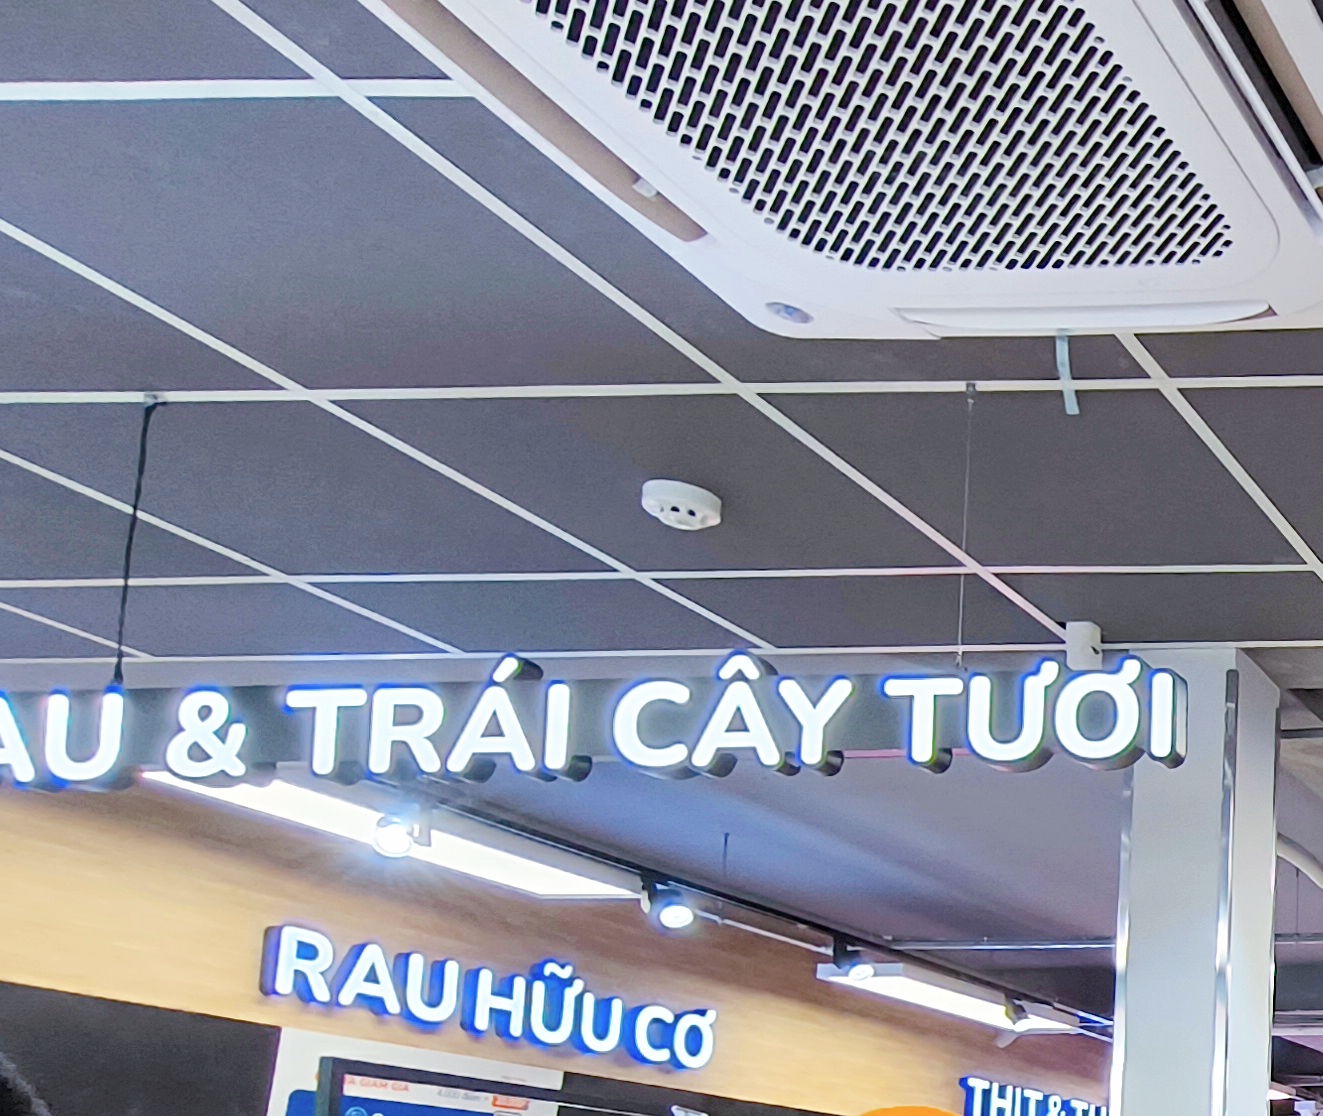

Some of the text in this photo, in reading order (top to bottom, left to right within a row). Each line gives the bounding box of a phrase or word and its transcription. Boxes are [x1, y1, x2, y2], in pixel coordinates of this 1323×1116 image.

[164, 689, 247, 778] &
[285, 653, 573, 777] TRÁI
[612, 650, 854, 769] CÂY
[882, 655, 1176, 767] TƯƠI
[272, 924, 718, 1069] RAU HỮU CƠ
